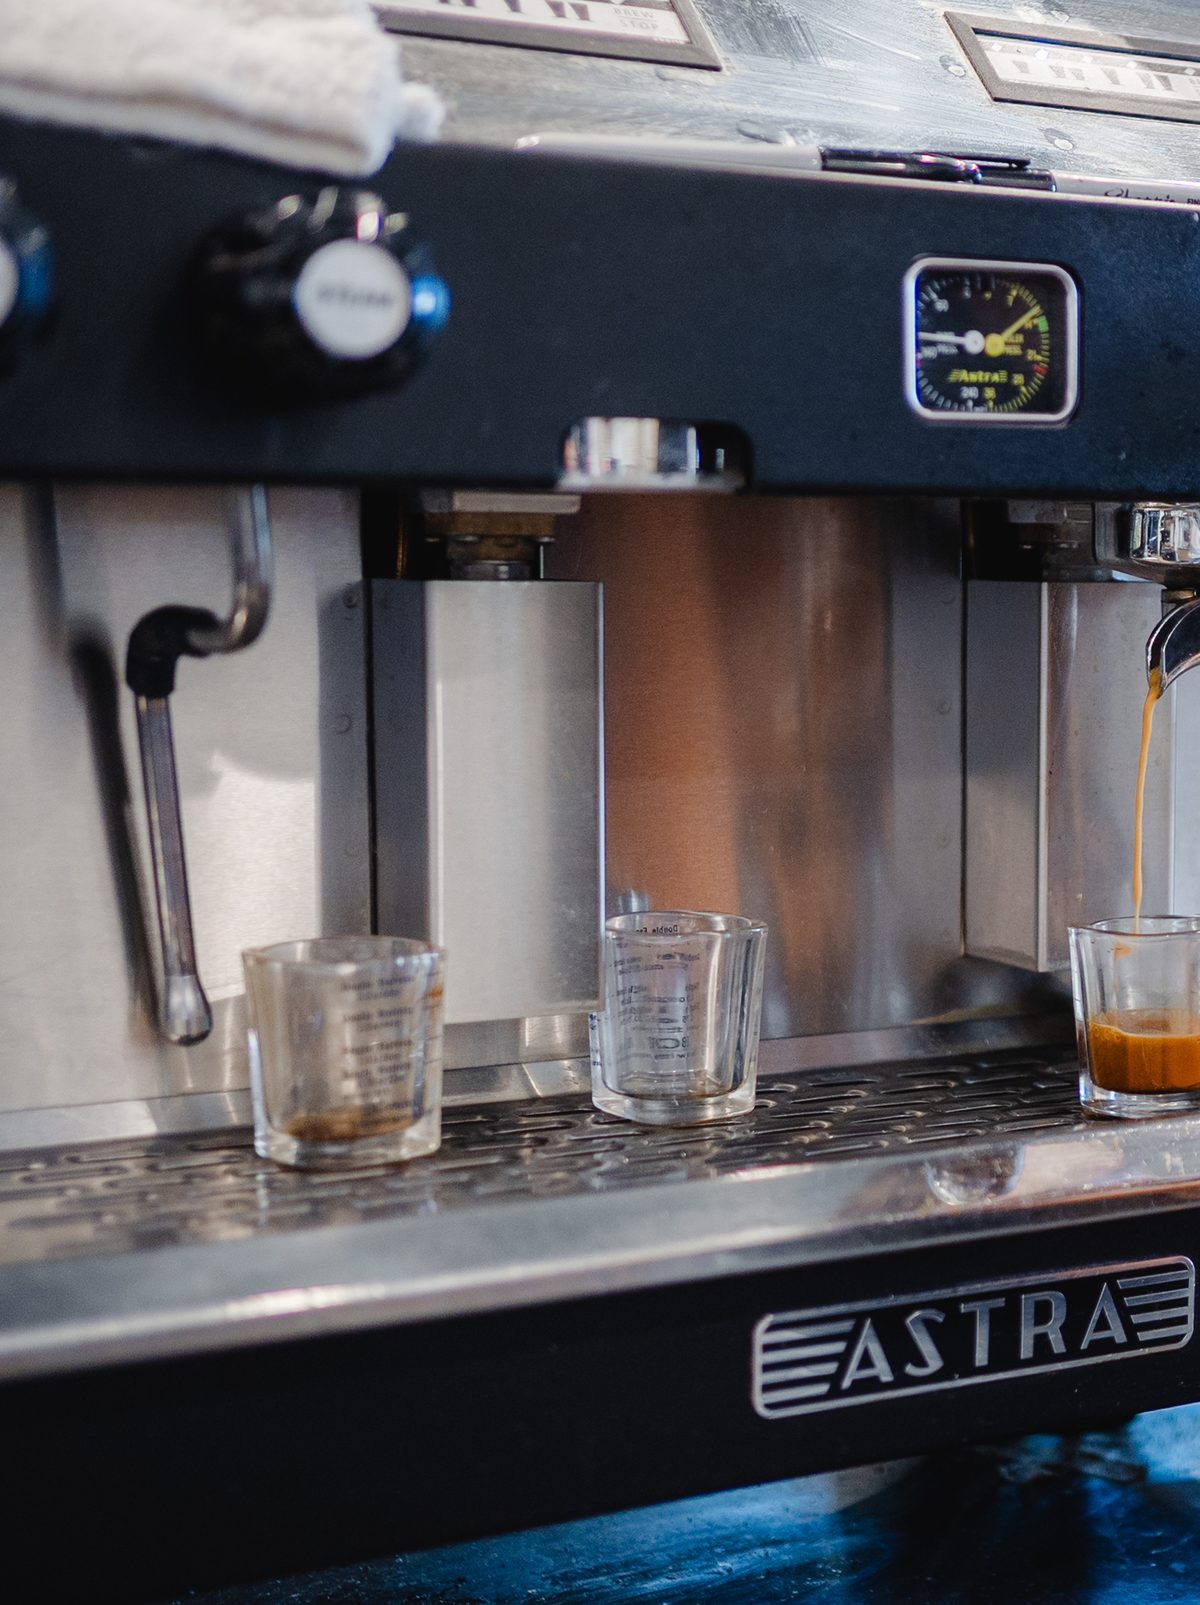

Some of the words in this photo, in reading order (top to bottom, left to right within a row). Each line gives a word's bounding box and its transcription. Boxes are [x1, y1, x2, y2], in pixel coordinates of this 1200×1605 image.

[614, 7, 654, 18] BREW
[620, 20, 659, 30] STOP
[841, 1282, 1128, 1390] ASTRA
